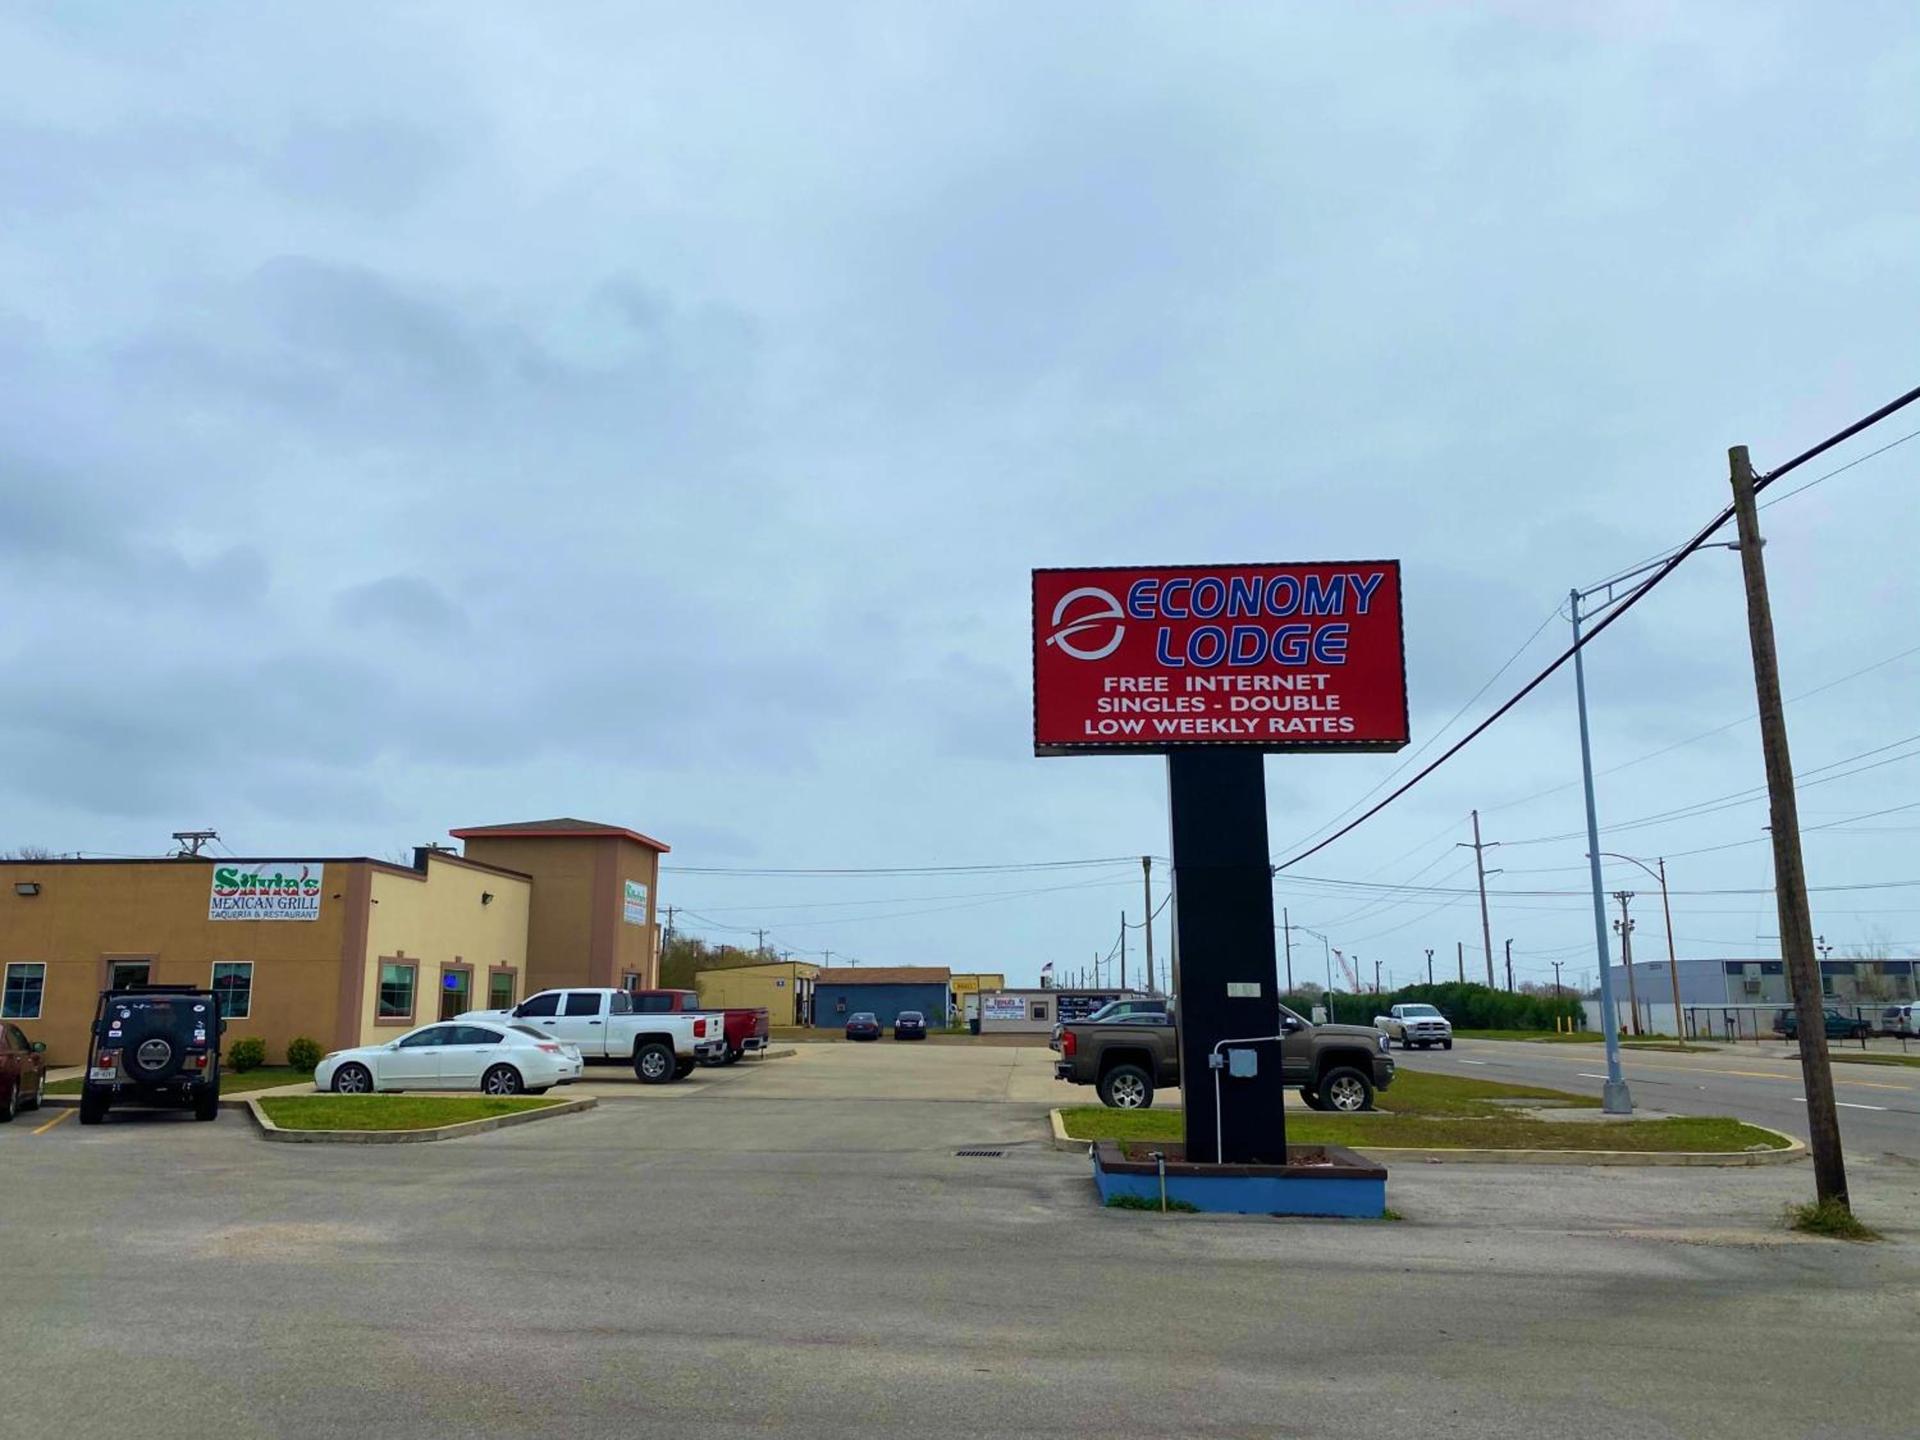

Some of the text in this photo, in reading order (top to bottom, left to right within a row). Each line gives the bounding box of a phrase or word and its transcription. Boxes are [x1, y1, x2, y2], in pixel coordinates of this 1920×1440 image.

[1128, 573, 1384, 619] ECONOMY
[1156, 623, 1349, 668] LODGE
[1103, 674, 1331, 692] FREE INTERNET
[1097, 696, 1206, 713] SINGLES
[1230, 694, 1341, 712] DOUBLE
[1084, 716, 1355, 735] LOW WEEKLY RATES
[213, 866, 320, 896] Silvia's
[211, 897, 318, 910] MEXICAN GRILL
[211, 910, 318, 919] TAQUERIA & RESTAURANT
